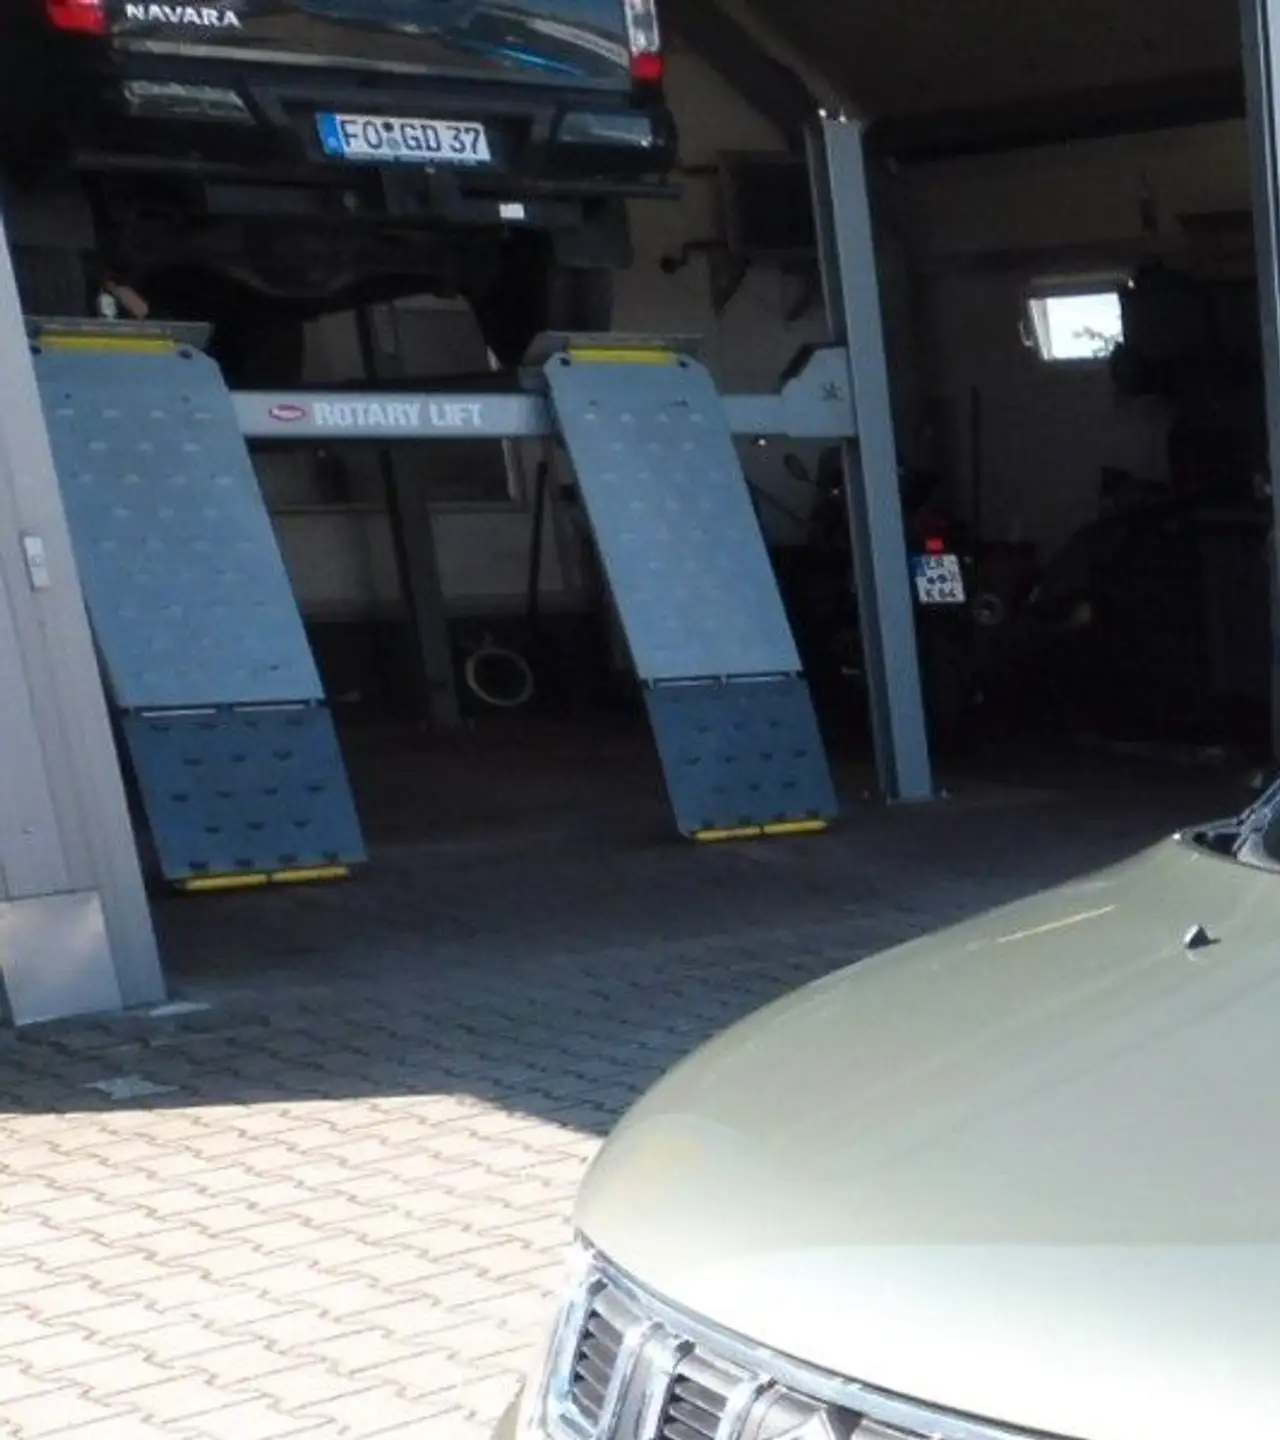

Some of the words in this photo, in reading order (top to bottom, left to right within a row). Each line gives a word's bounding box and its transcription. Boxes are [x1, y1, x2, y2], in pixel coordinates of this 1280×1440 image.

[123, 2, 242, 30] NAVARA
[340, 119, 384, 151] FO
[399, 122, 442, 153] GD
[445, 126, 481, 155] 37
[311, 401, 421, 428] ROTARY
[428, 402, 483, 429] LIFT
